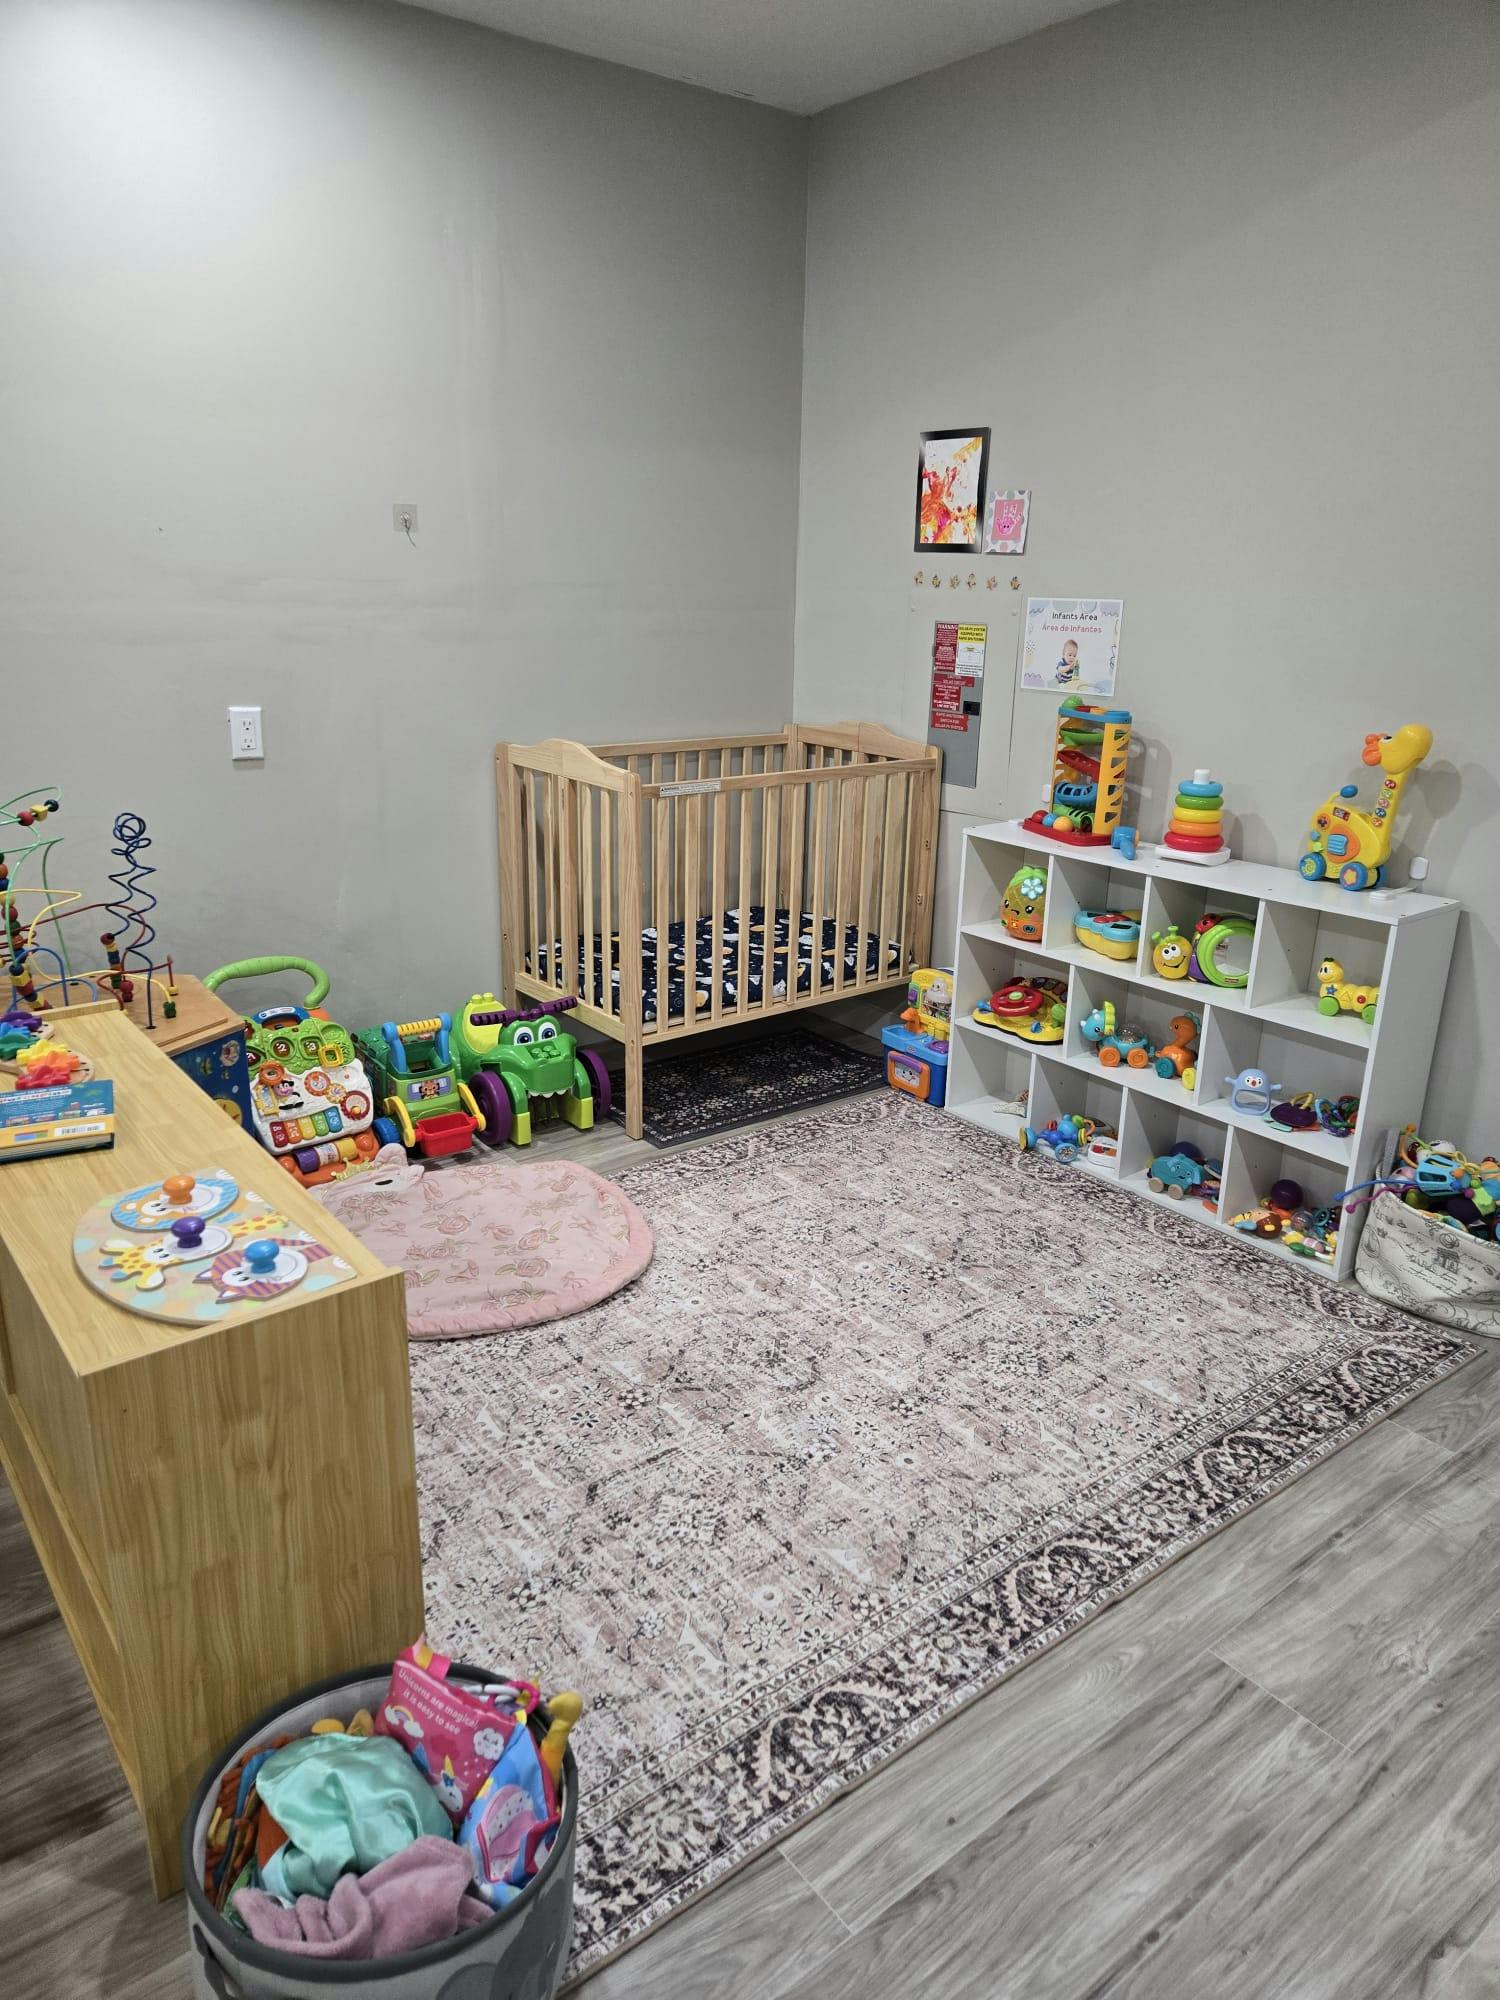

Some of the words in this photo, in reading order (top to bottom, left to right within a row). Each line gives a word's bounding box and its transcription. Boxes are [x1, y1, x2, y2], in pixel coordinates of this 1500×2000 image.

[1051, 611, 1078, 620] Infants
[1060, 624, 1069, 632] de
[1070, 625, 1102, 633] Infantes
[399, 1667, 430, 1700] Unicorns
[430, 1696, 445, 1710] are
[444, 1705, 480, 1730] magical,
[403, 1688, 410, 1699] it
[409, 1695, 417, 1704] is
[417, 1701, 435, 1720] easy
[435, 1714, 445, 1726] to
[444, 1720, 461, 1735] see
